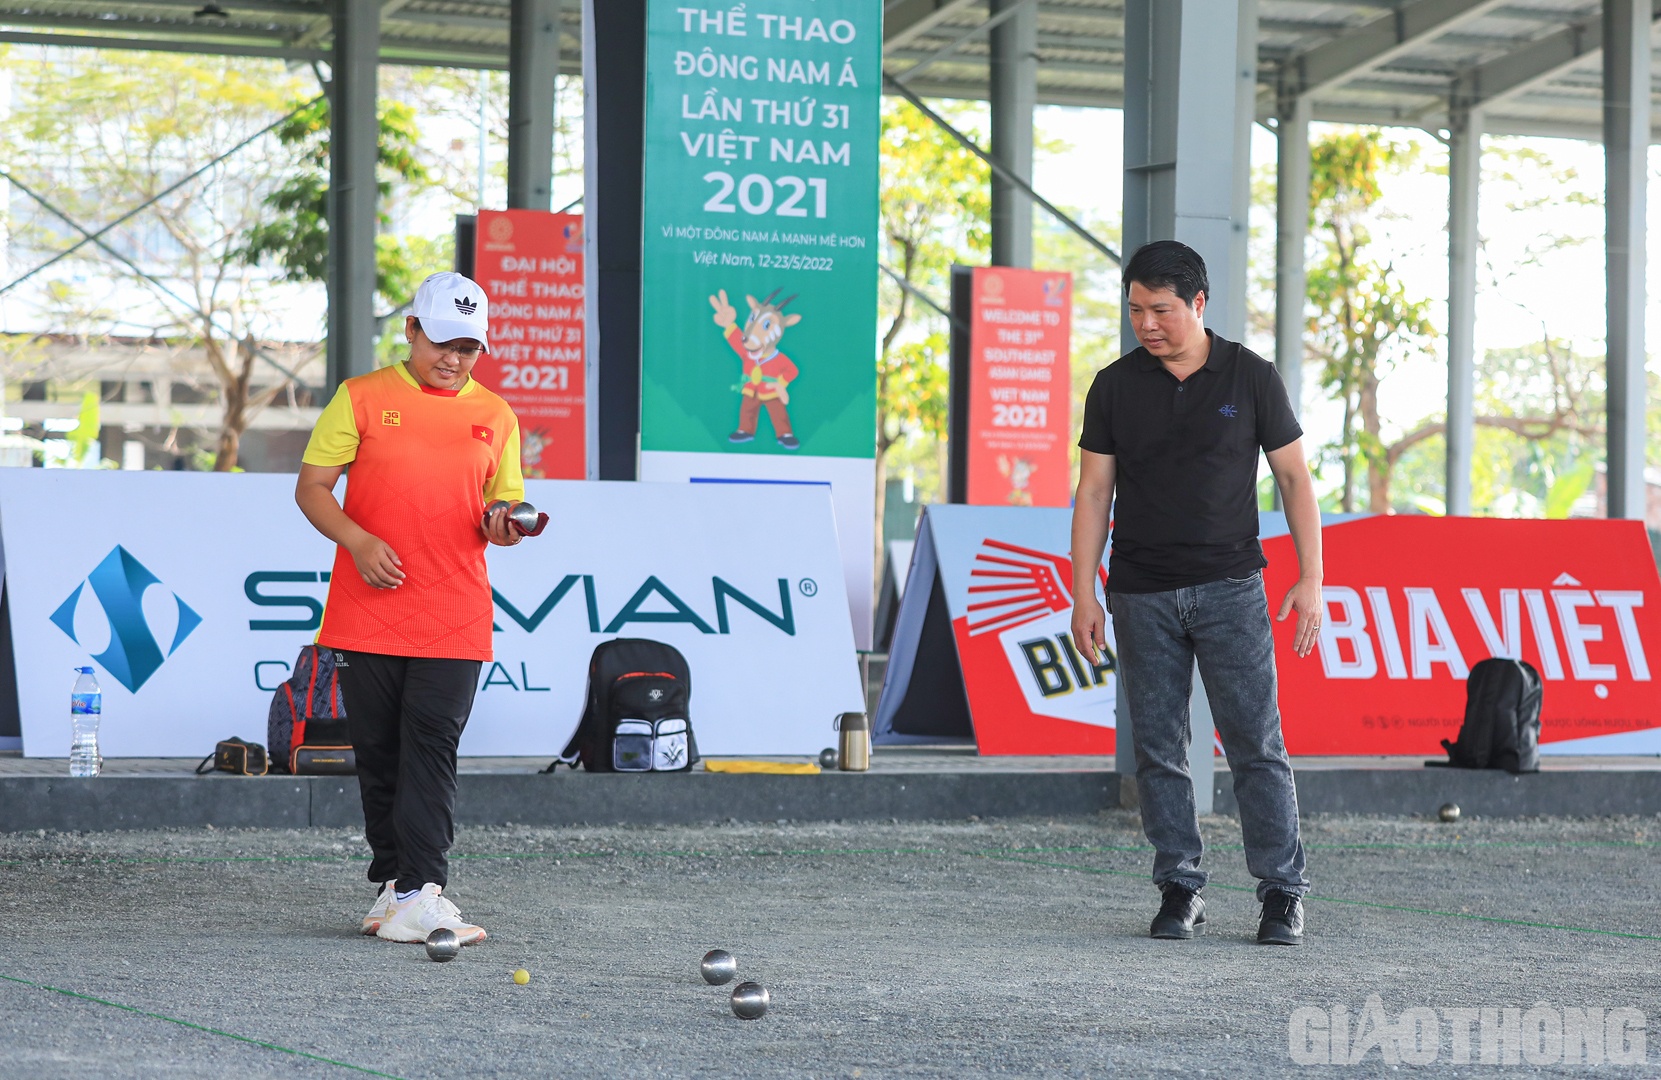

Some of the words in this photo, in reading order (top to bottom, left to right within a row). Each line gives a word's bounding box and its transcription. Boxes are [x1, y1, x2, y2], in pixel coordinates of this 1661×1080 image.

[677, 2, 747, 37] THỂ
[756, 13, 856, 44] THAO
[674, 46, 759, 81] ĐÔNG
[767, 57, 830, 86] NAM
[837, 57, 859, 88] Á
[682, 87, 742, 122] LẦN
[751, 96, 817, 127] THỨ
[822, 103, 849, 129] 31
[680, 128, 760, 166] VIỆT
[770, 137, 850, 166] NAM
[703, 170, 827, 219] 2021
[661, 223, 674, 238] VÌ
[676, 224, 702, 240] MỘT
[704, 226, 740, 242] ĐÔNG
[741, 229, 769, 244] NAM
[771, 229, 780, 244] Á
[782, 232, 817, 247] MẠNH
[839, 234, 866, 249] HƠN
[501, 256, 537, 275] ĐẠI
[540, 255, 577, 277] HỘI
[693, 250, 718, 268] Việt
[721, 252, 755, 269] Nam,
[757, 253, 834, 272] 12-23/5/2022
[490, 275, 528, 298] THỂ
[532, 281, 584, 299] THAO
[488, 300, 533, 320] ĐÔNG
[536, 304, 571, 320] NAM
[981, 309, 1041, 325] WELCOME
[1043, 311, 1060, 326] TO
[528, 324, 563, 342] THỨ
[565, 326, 582, 343] 31
[998, 328, 1021, 343] THE
[490, 343, 532, 363] VIỆT
[536, 346, 582, 363] NAM
[983, 347, 1056, 364] SOUTHEAST
[500, 364, 569, 390] 2021
[992, 404, 1047, 428] 2021
[1317, 586, 1470, 679] BIA
[1461, 571, 1652, 699] VIỆT
